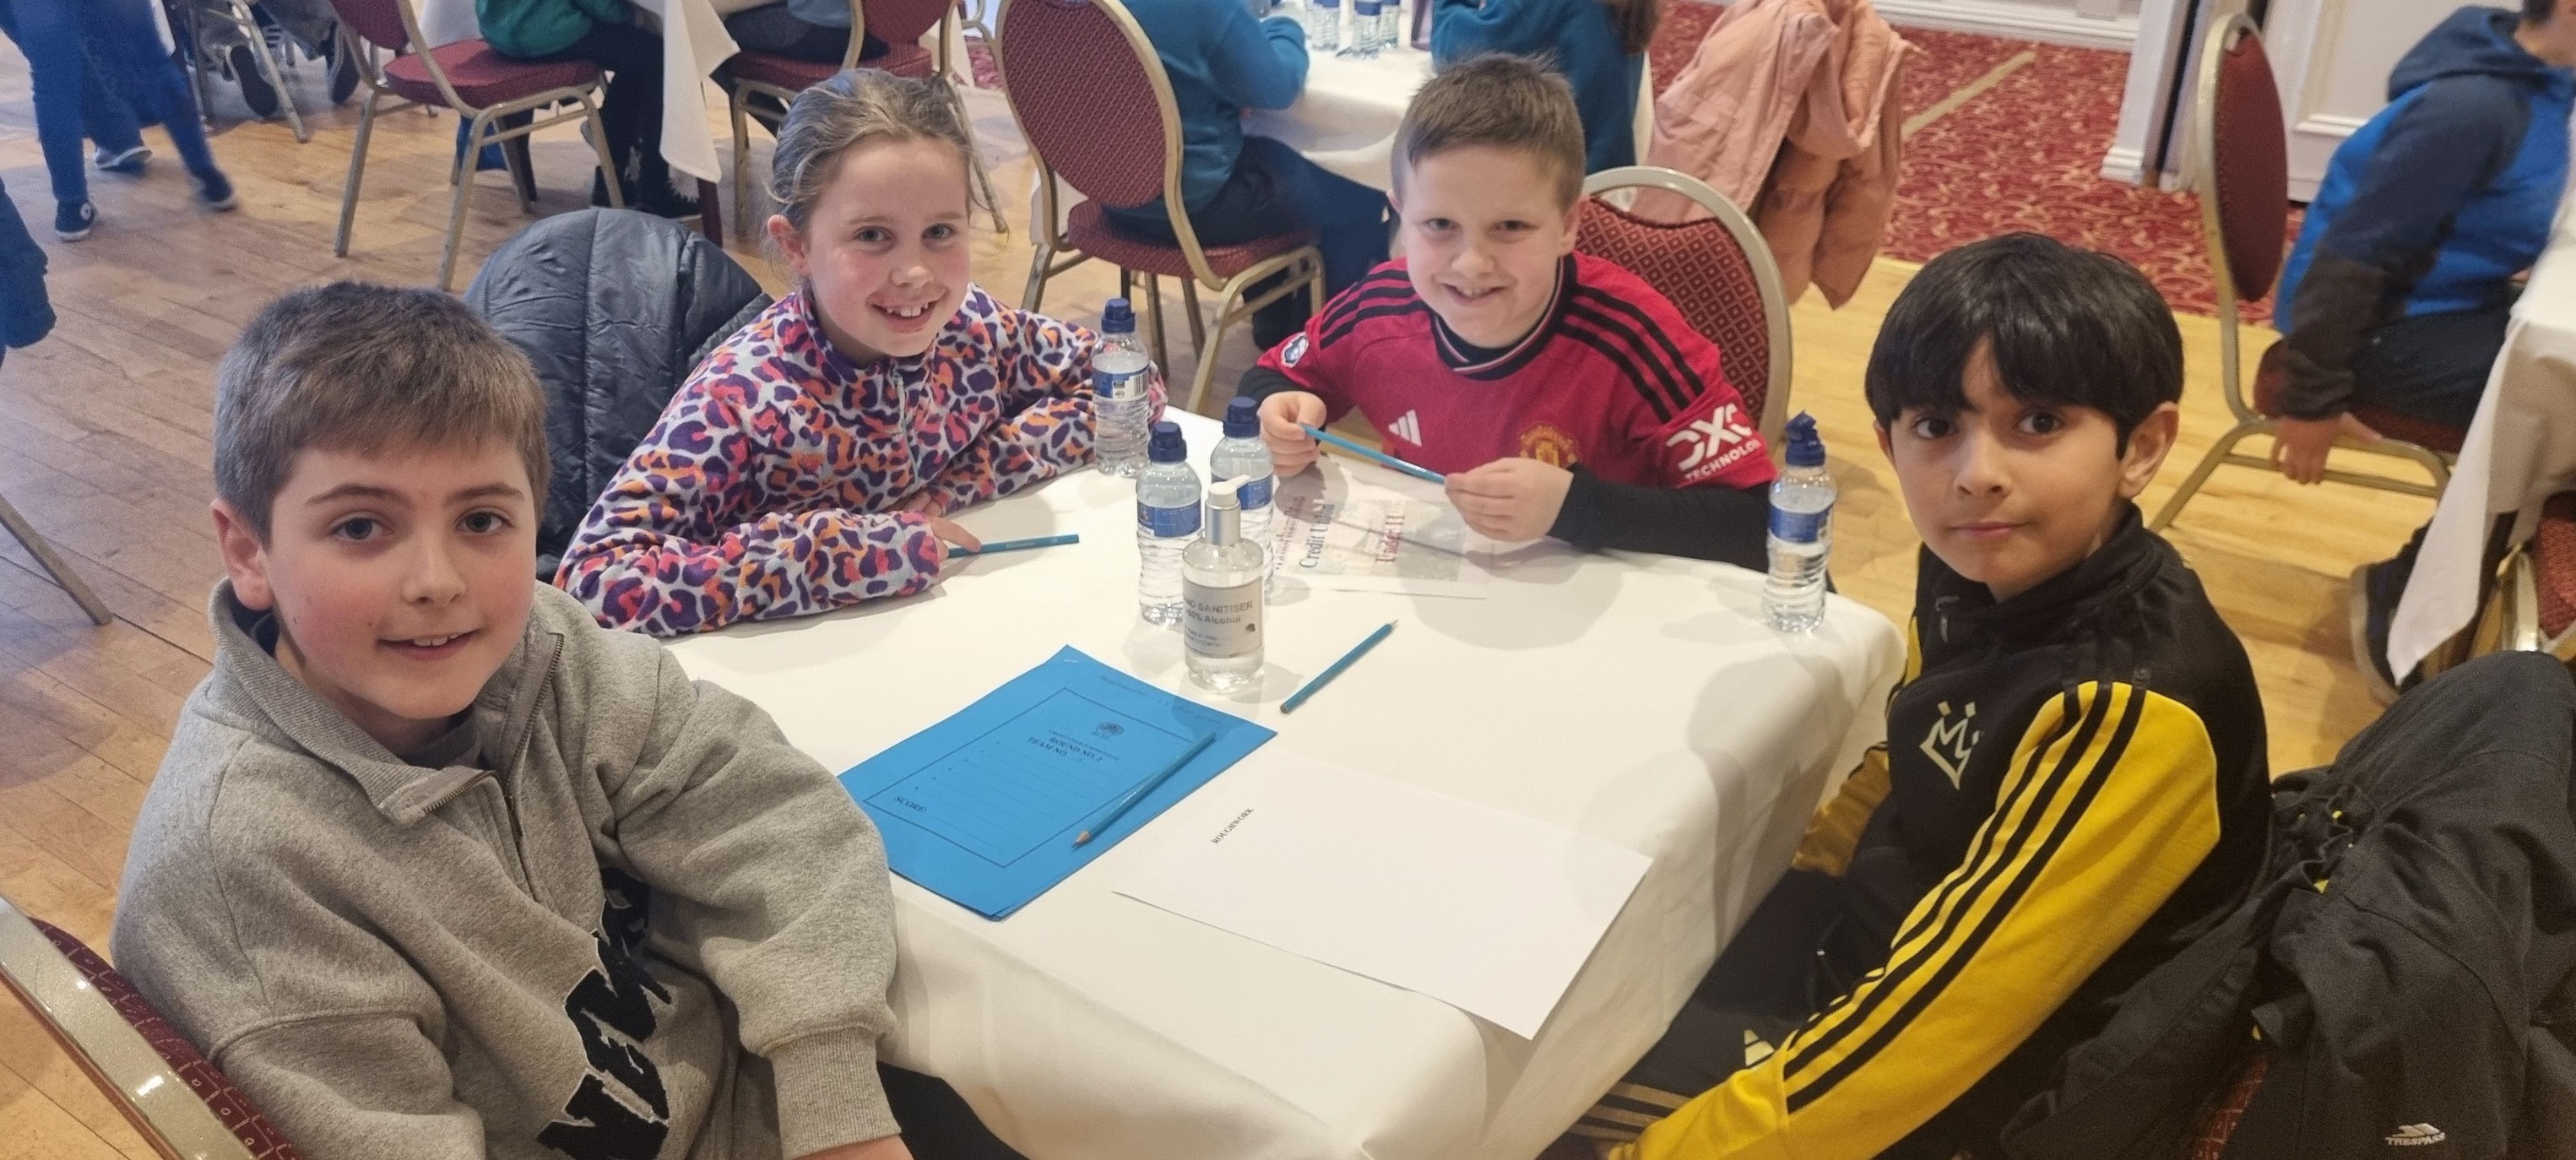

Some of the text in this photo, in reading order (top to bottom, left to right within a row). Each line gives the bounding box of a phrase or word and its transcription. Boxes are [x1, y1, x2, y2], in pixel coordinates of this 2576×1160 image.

[1299, 535, 1326, 568] Credit
[1198, 600, 1254, 614] SANITISER
[1205, 615, 1241, 625] Alcohol
[1211, 808, 1255, 844] ROUGHWORK
